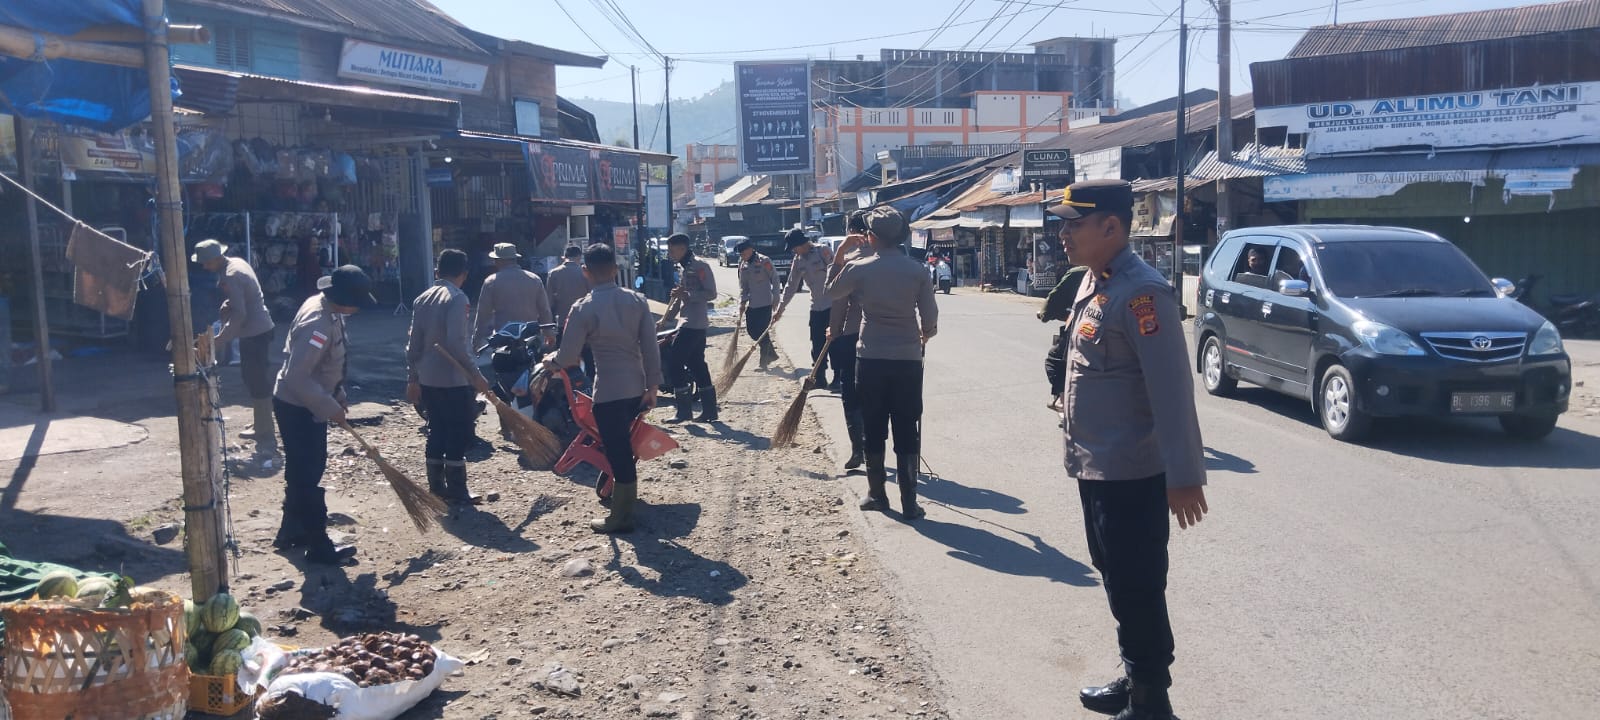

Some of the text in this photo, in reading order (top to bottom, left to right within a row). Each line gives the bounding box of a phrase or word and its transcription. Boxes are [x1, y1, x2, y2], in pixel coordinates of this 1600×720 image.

[378, 50, 443, 75] MUTIARA
[1307, 84, 1581, 119] UD. ALIMU TANI
[1315, 119, 1353, 127] MENJUAL
[1354, 116, 1383, 125] SEGALA
[1385, 114, 1414, 123] MACAM
[1349, 123, 1384, 132] TAKENGON
[1033, 152, 1060, 161] LUNA
[553, 162, 587, 183] PRIMA
[610, 166, 637, 185] PRIMA
[1501, 395, 1512, 408] NE
